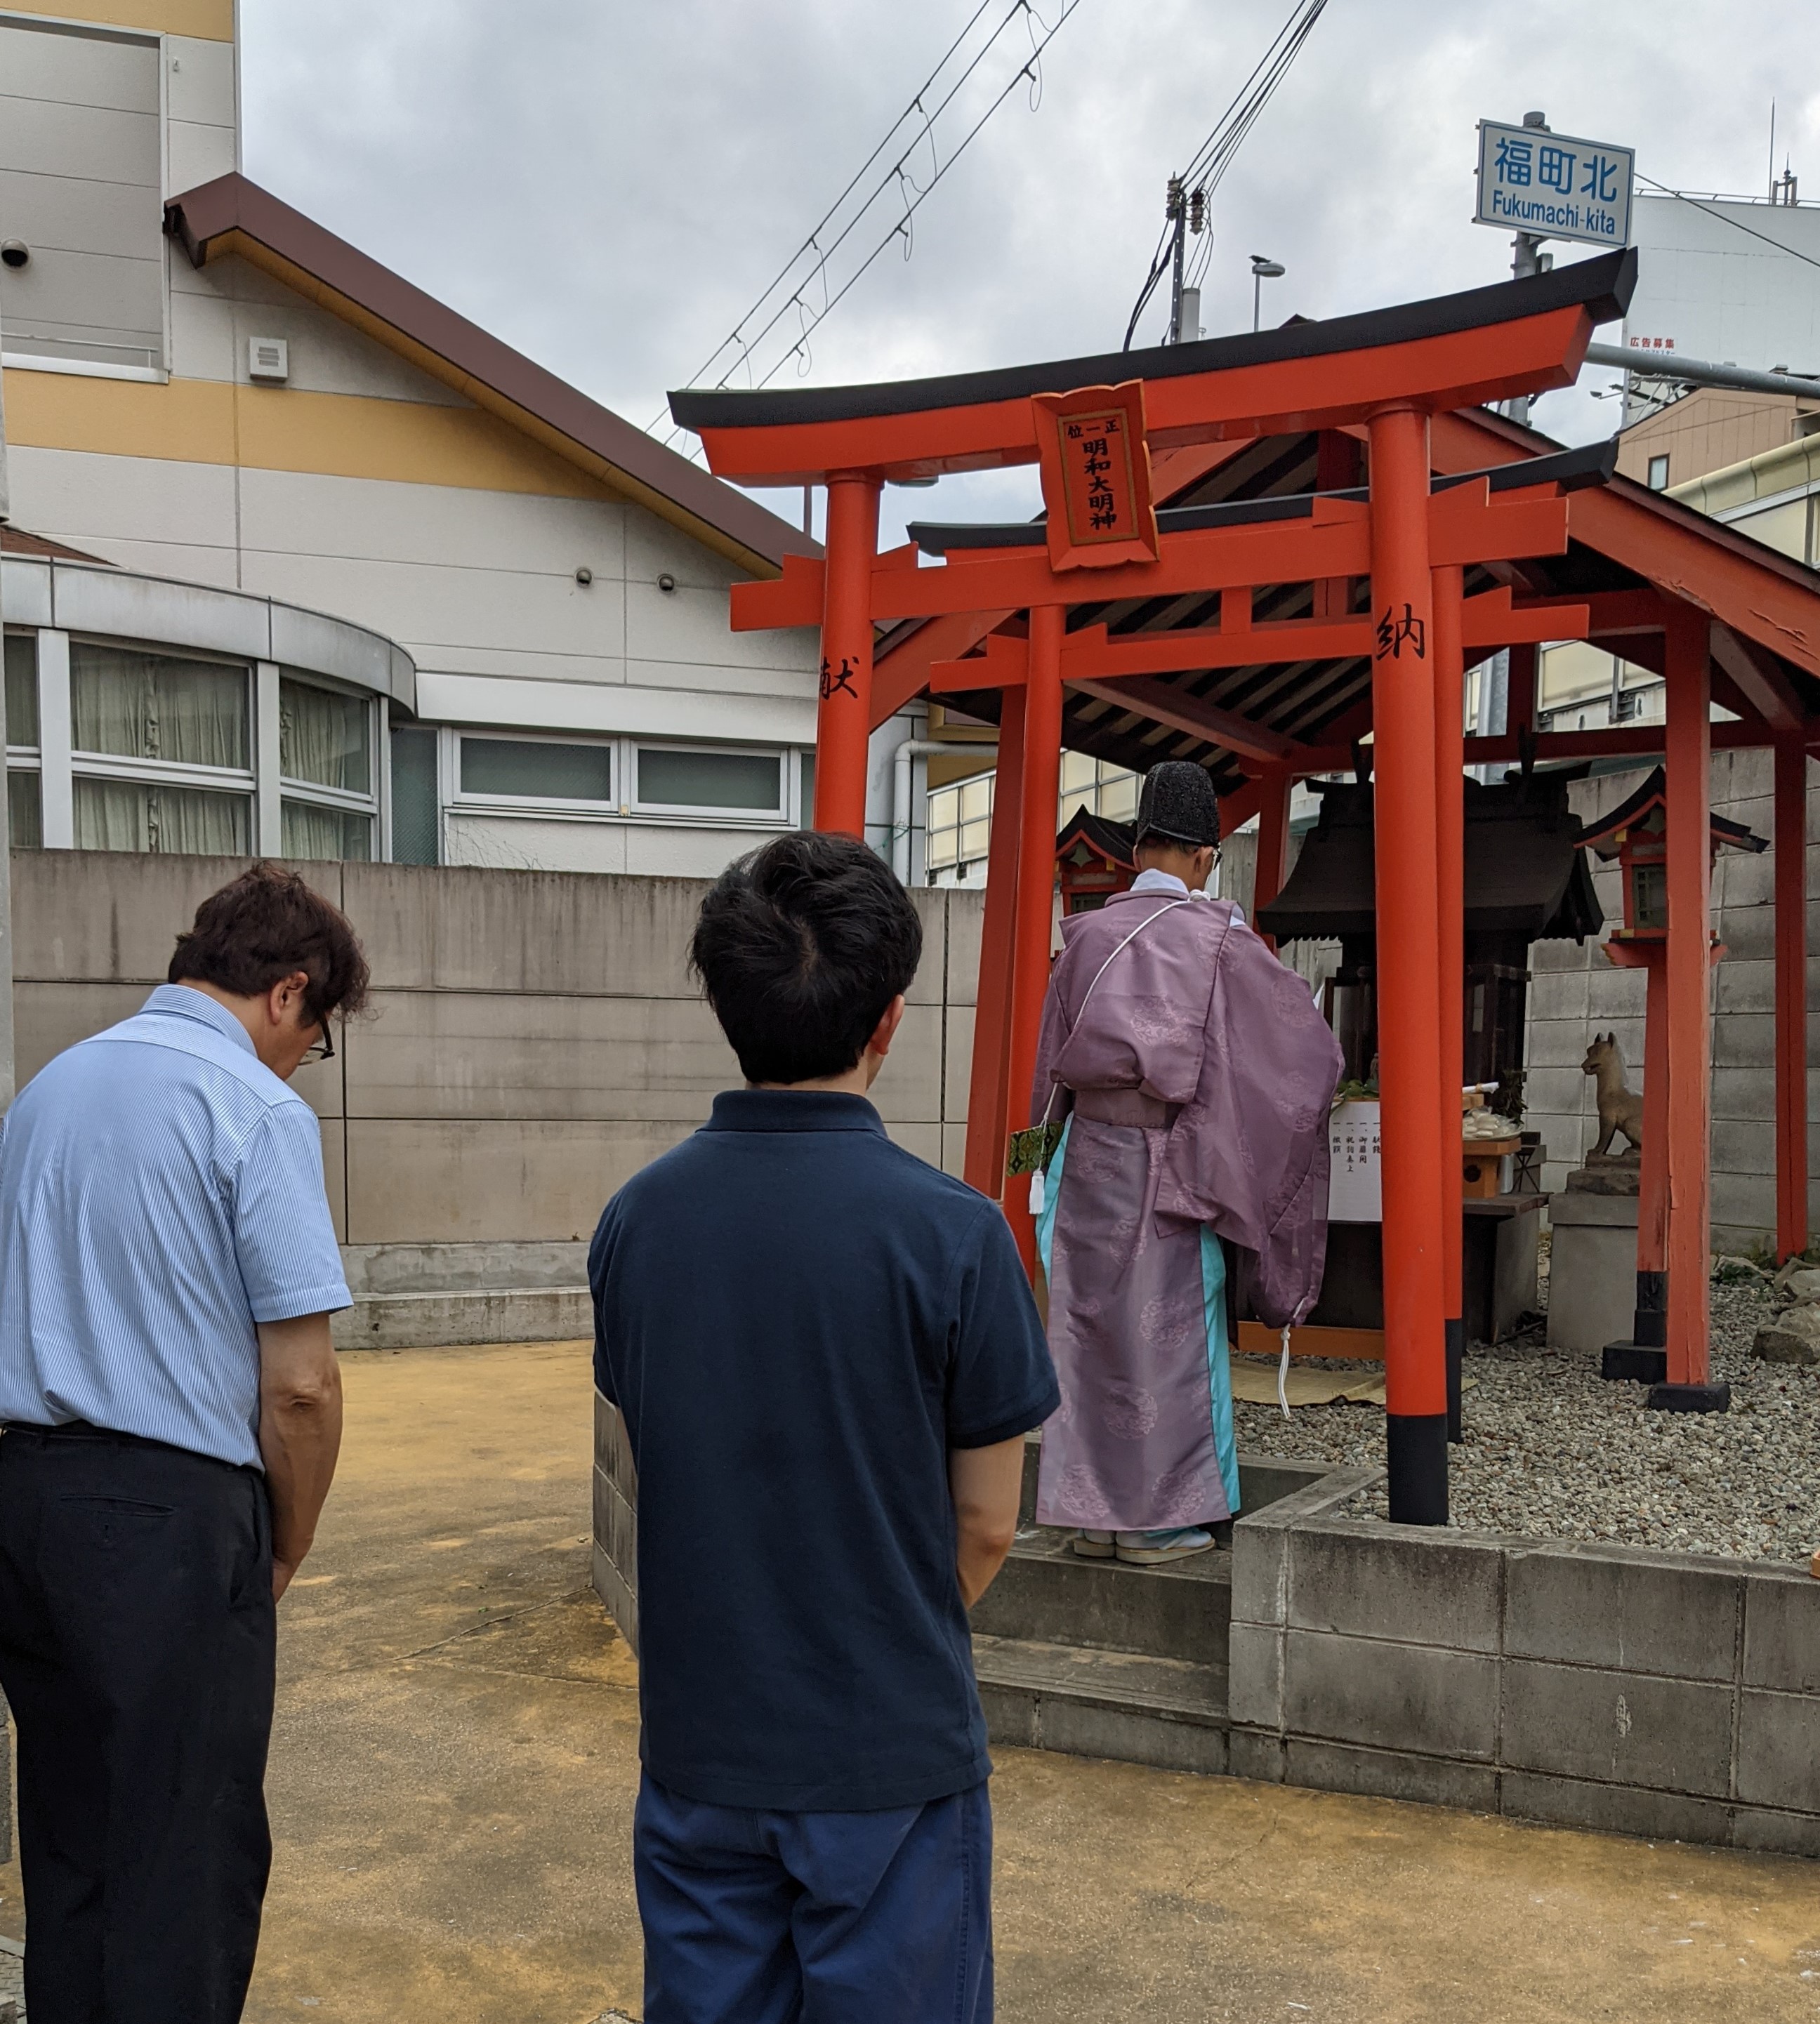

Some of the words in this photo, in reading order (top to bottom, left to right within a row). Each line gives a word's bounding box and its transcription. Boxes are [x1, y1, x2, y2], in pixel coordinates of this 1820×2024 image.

[1494, 137, 1617, 202] 福町北
[1493, 190, 1615, 234] Fukumachi-kita
[1630, 337, 1675, 349] 広告募集
[1082, 437, 1117, 531] 明和大明神
[1376, 602, 1425, 661] 納
[820, 656, 859, 700] 献
